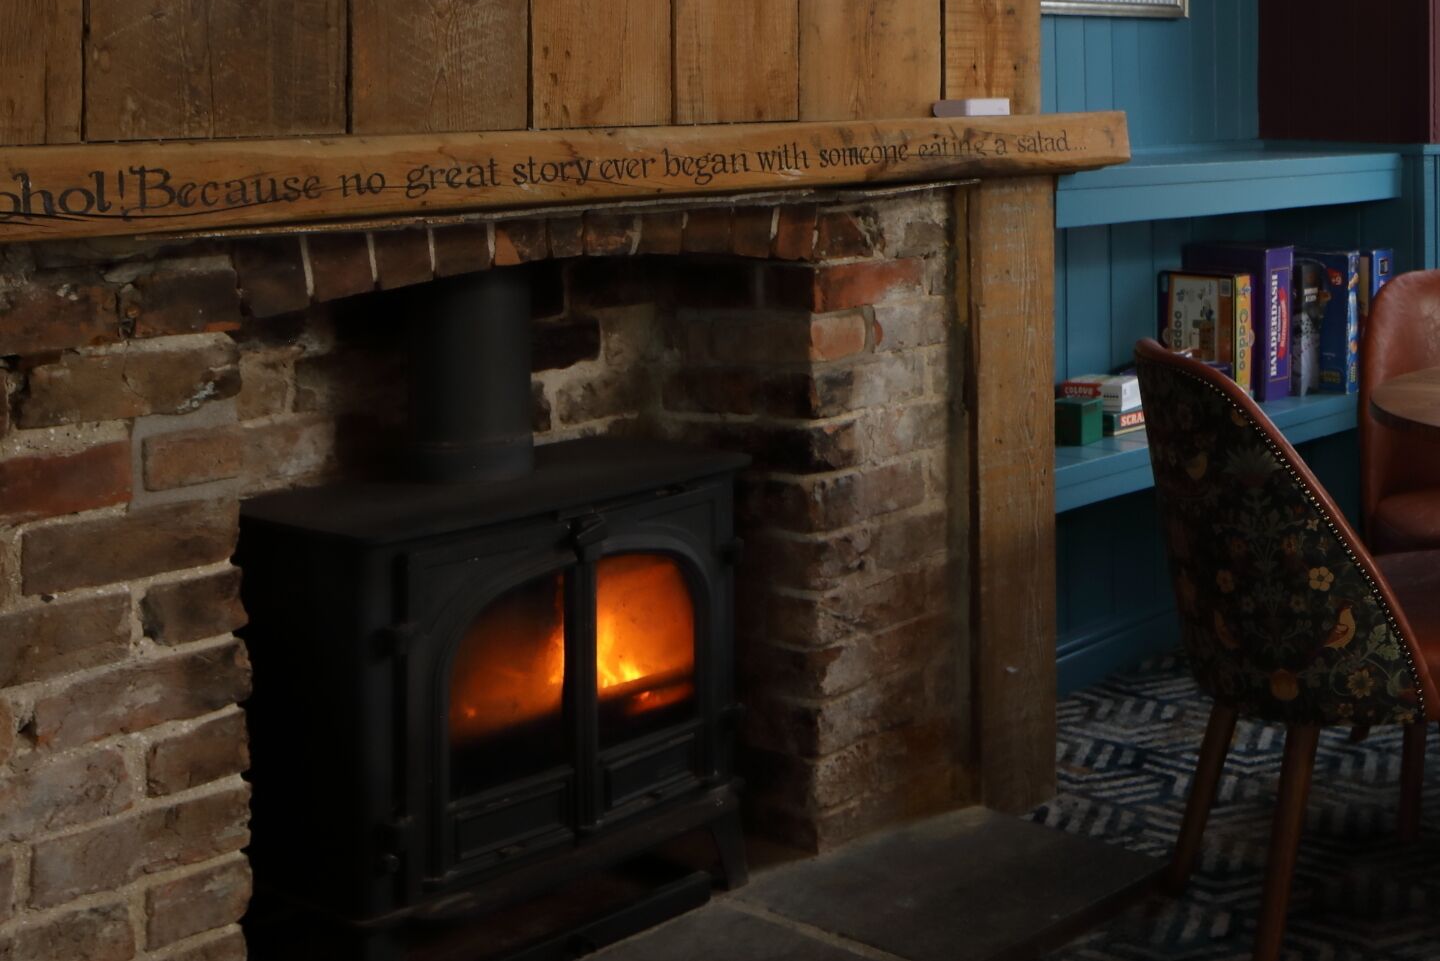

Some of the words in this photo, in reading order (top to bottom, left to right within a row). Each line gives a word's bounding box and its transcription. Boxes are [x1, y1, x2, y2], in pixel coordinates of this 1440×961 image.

[122, 165, 322, 222] Because
[340, 172, 386, 198] no
[405, 158, 501, 200] great
[512, 156, 593, 185] story
[600, 155, 656, 181] ever
[663, 147, 750, 186] began
[756, 142, 809, 172] with
[820, 143, 910, 169] someone
[918, 134, 988, 158] eating
[995, 137, 1008, 156] a
[1240, 308, 1249, 370] Cadoo
[1270, 274, 1279, 377] BALDERDASH
